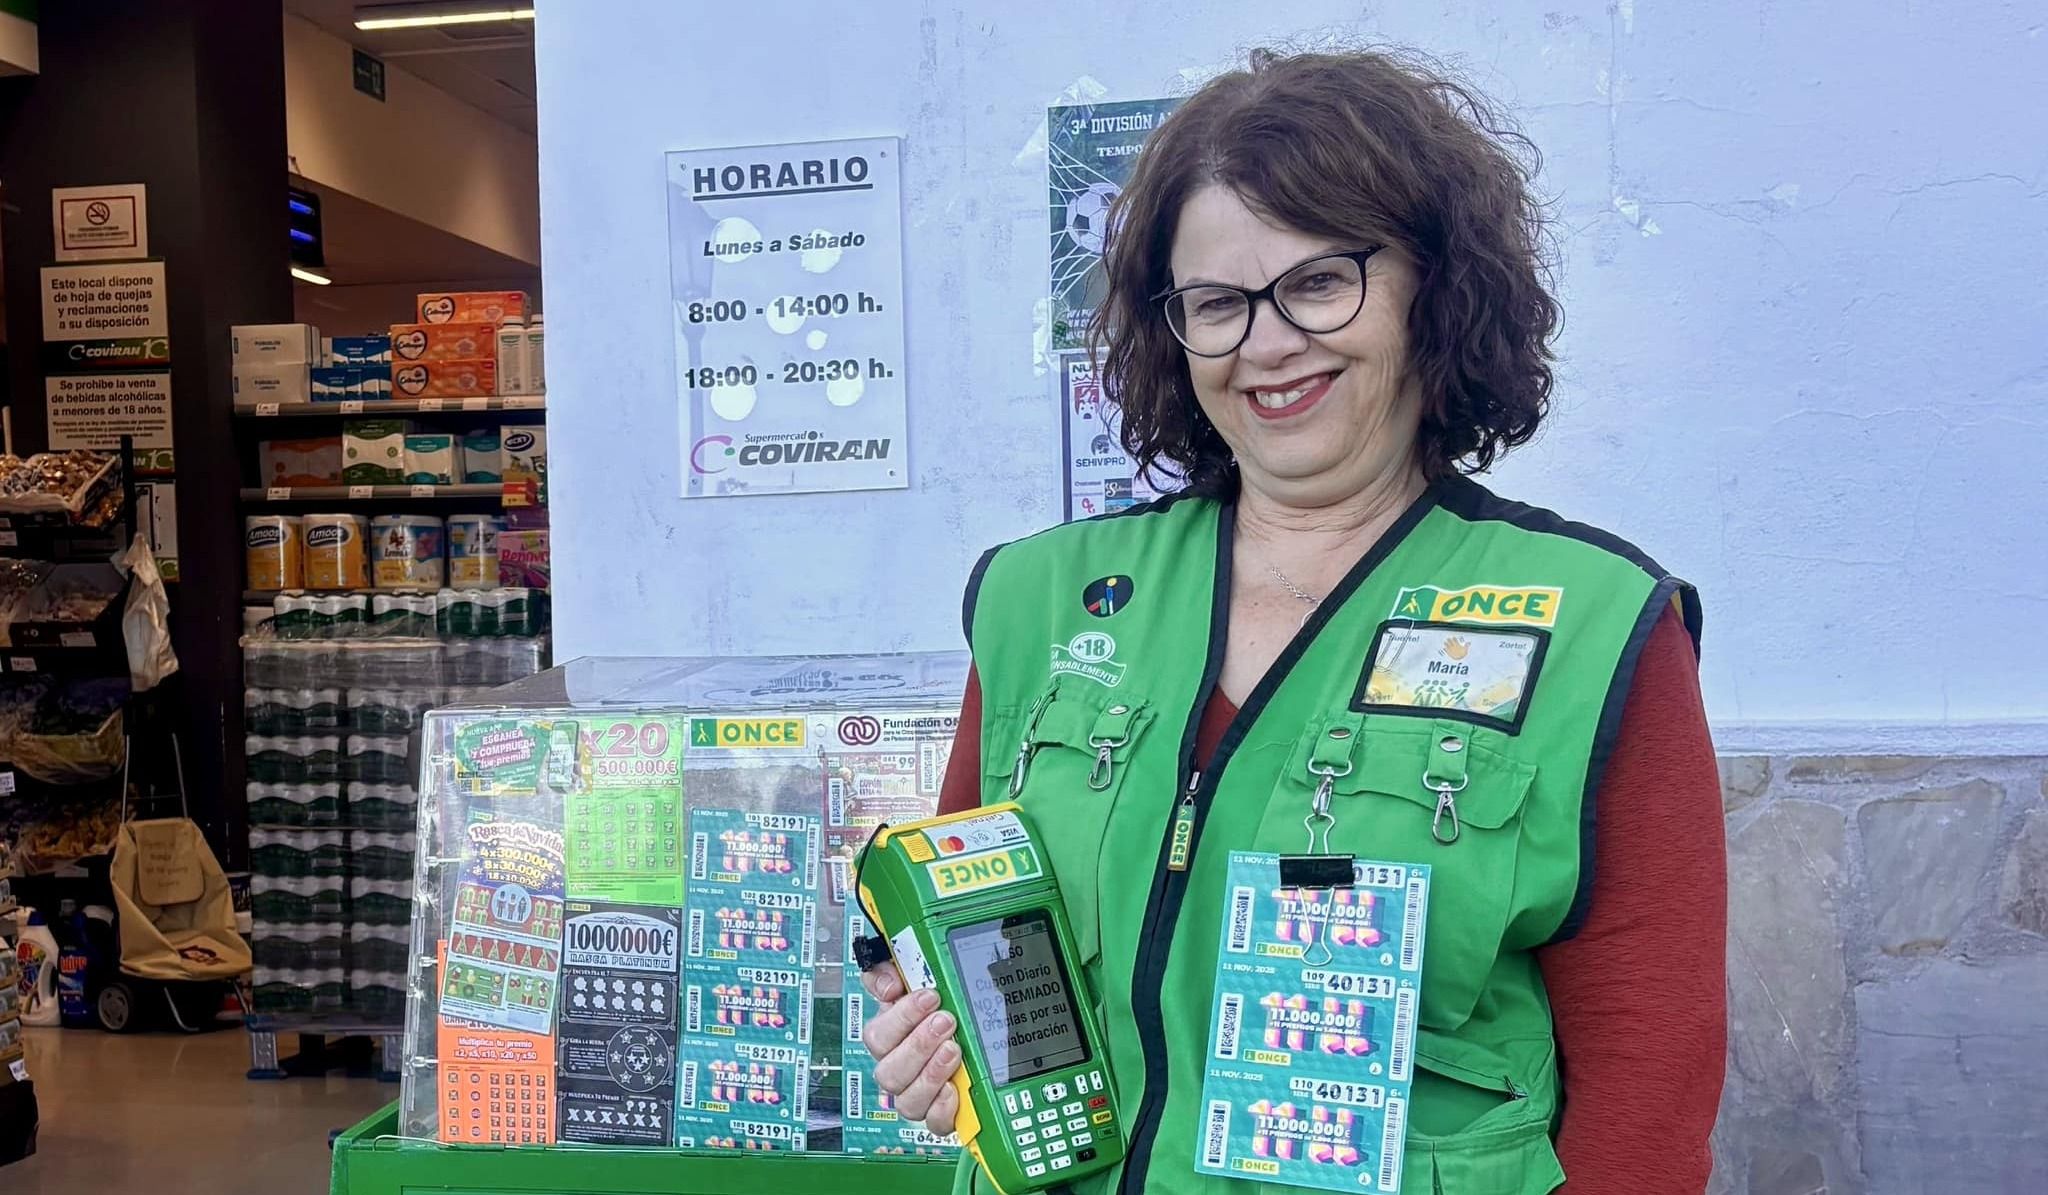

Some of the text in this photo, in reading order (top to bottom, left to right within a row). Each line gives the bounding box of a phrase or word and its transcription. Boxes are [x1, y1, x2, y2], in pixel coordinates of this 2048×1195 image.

[1091, 112, 1153, 135] DIVISIÓN
[692, 156, 870, 195] HORARIO
[703, 231, 866, 257] Lunes a Sábado
[51, 276, 154, 289] Este local dispone
[53, 289, 153, 303] de hoja de quejas
[57, 304, 149, 318] y reclamaciones
[687, 299, 748, 324] 8:00
[773, 293, 850, 318] 14:00
[857, 291, 884, 313] h.
[58, 316, 150, 330] a su disposición
[684, 365, 758, 390] 18:00
[782, 359, 861, 385] 20:30
[868, 358, 895, 379] h.
[60, 379, 156, 391] Se prohibe la venta
[51, 391, 167, 403] de bebidas alcohólicas
[53, 404, 167, 416] a menores de 18 años.
[738, 438, 892, 467] COVIRAN
[1441, 590, 1551, 619] ONCE
[1075, 639, 1107, 657] +18
[1427, 660, 1470, 676] María
[883, 717, 942, 730] Fundación
[723, 722, 799, 743] ONCE
[763, 817, 805, 831] 82191
[1171, 822, 1190, 864] ONCE
[939, 856, 1008, 889] ONCE
[1354, 866, 1402, 886] 0131
[758, 893, 800, 908] 82191
[1269, 944, 1300, 956] ONCE
[570, 952, 671, 969] RASCA PLATINUM
[755, 970, 797, 985] 82191
[1015, 964, 1052, 982] Diario
[1305, 971, 1325, 982] 109
[1327, 973, 1391, 996] 40131
[995, 981, 1061, 1006] PREMIADO
[1030, 1005, 1051, 1023] por
[1053, 1002, 1068, 1014] su
[752, 1046, 793, 1062] 82191
[1257, 1053, 1289, 1065] ONCE
[1294, 1079, 1314, 1090] 110
[1315, 1082, 1381, 1105] 40131
[747, 1123, 789, 1139] 82191
[1245, 1161, 1277, 1172] ONCE
